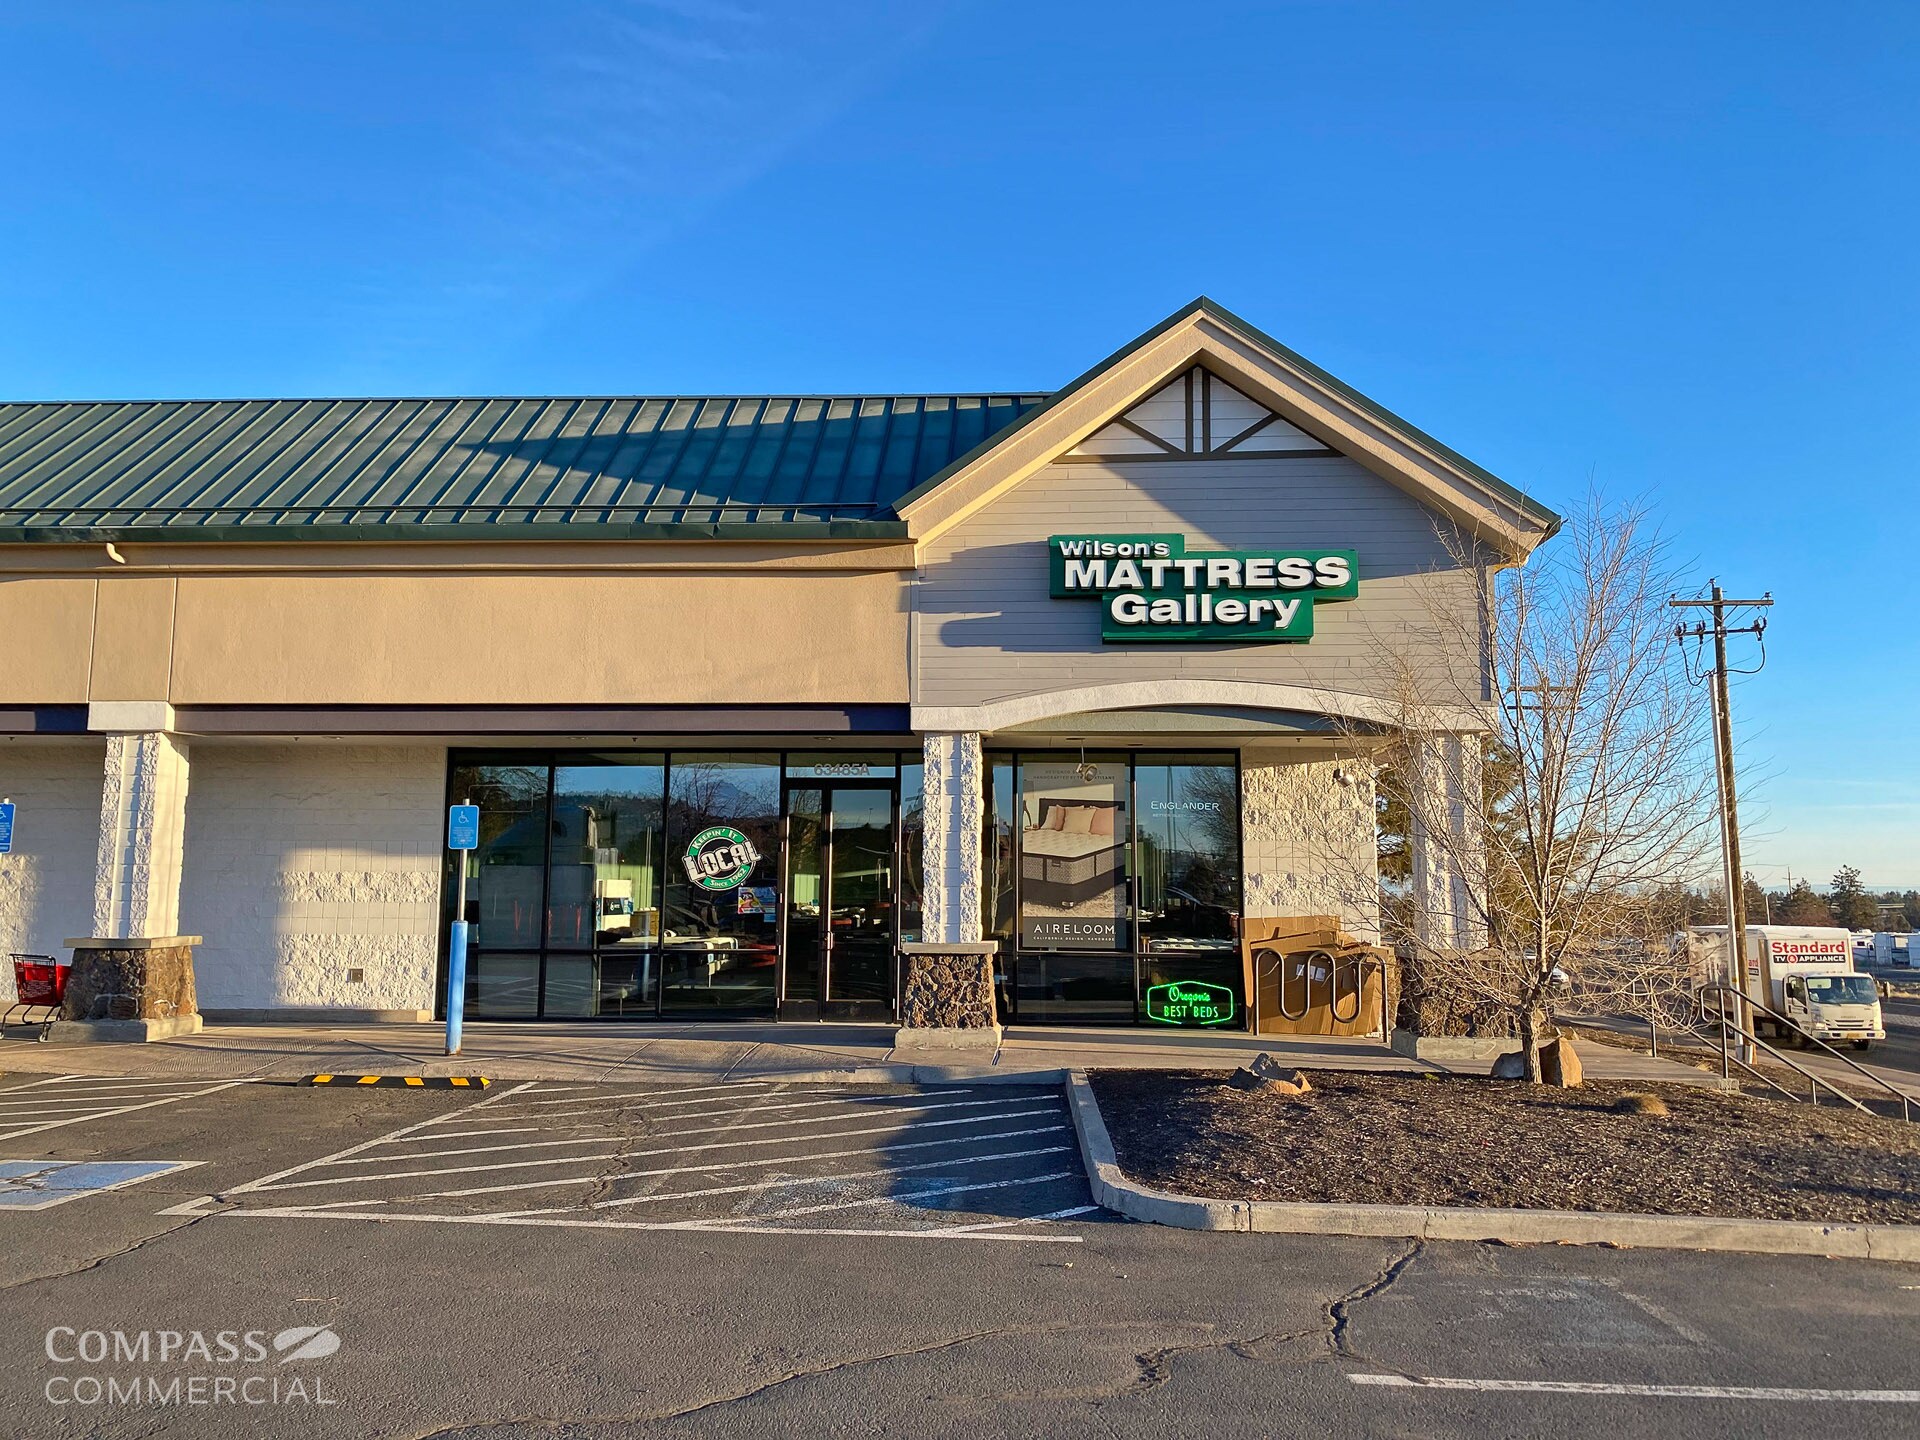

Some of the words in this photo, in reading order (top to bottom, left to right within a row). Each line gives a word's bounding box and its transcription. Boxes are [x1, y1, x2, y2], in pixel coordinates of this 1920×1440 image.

[1059, 540, 1171, 558] Wilson's
[1063, 556, 1351, 590] MATTRESS
[1110, 593, 1303, 629] Gallery
[814, 763, 870, 776] 63485A
[1151, 801, 1220, 811] ENGLANDER
[683, 839, 762, 881] LOCAL
[729, 868, 746, 883] 1962
[1033, 924, 1115, 935] AIRELOOM
[1772, 941, 1845, 953] Standard
[1164, 1005, 1187, 1018] BEST
[1193, 1006, 1219, 1018] BEDS
